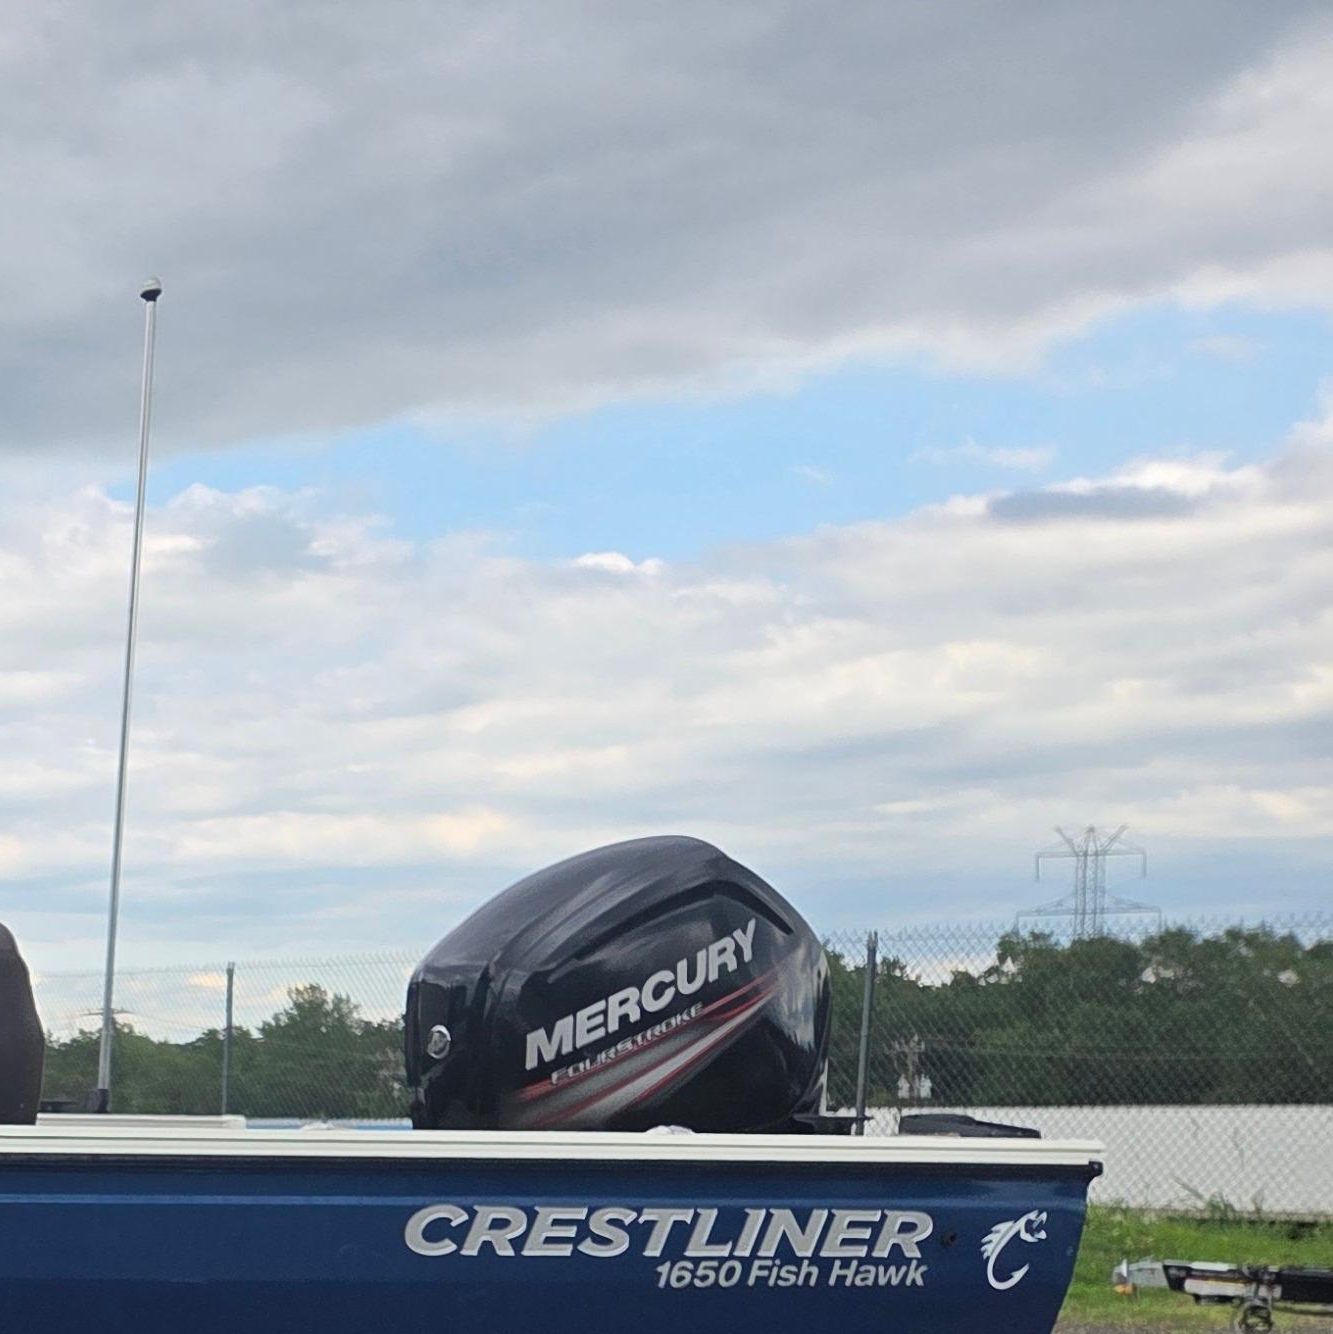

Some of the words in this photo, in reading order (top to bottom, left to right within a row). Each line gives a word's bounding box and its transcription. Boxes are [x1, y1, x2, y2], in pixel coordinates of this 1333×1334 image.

[525, 918, 756, 1071] MERCURY
[551, 1001, 704, 1085] FOURSTROKE
[404, 1204, 934, 1258] CRESTLINER
[655, 1259, 743, 1289] 1650
[747, 1258, 819, 1288] Fish
[828, 1258, 929, 1288] Hawk
